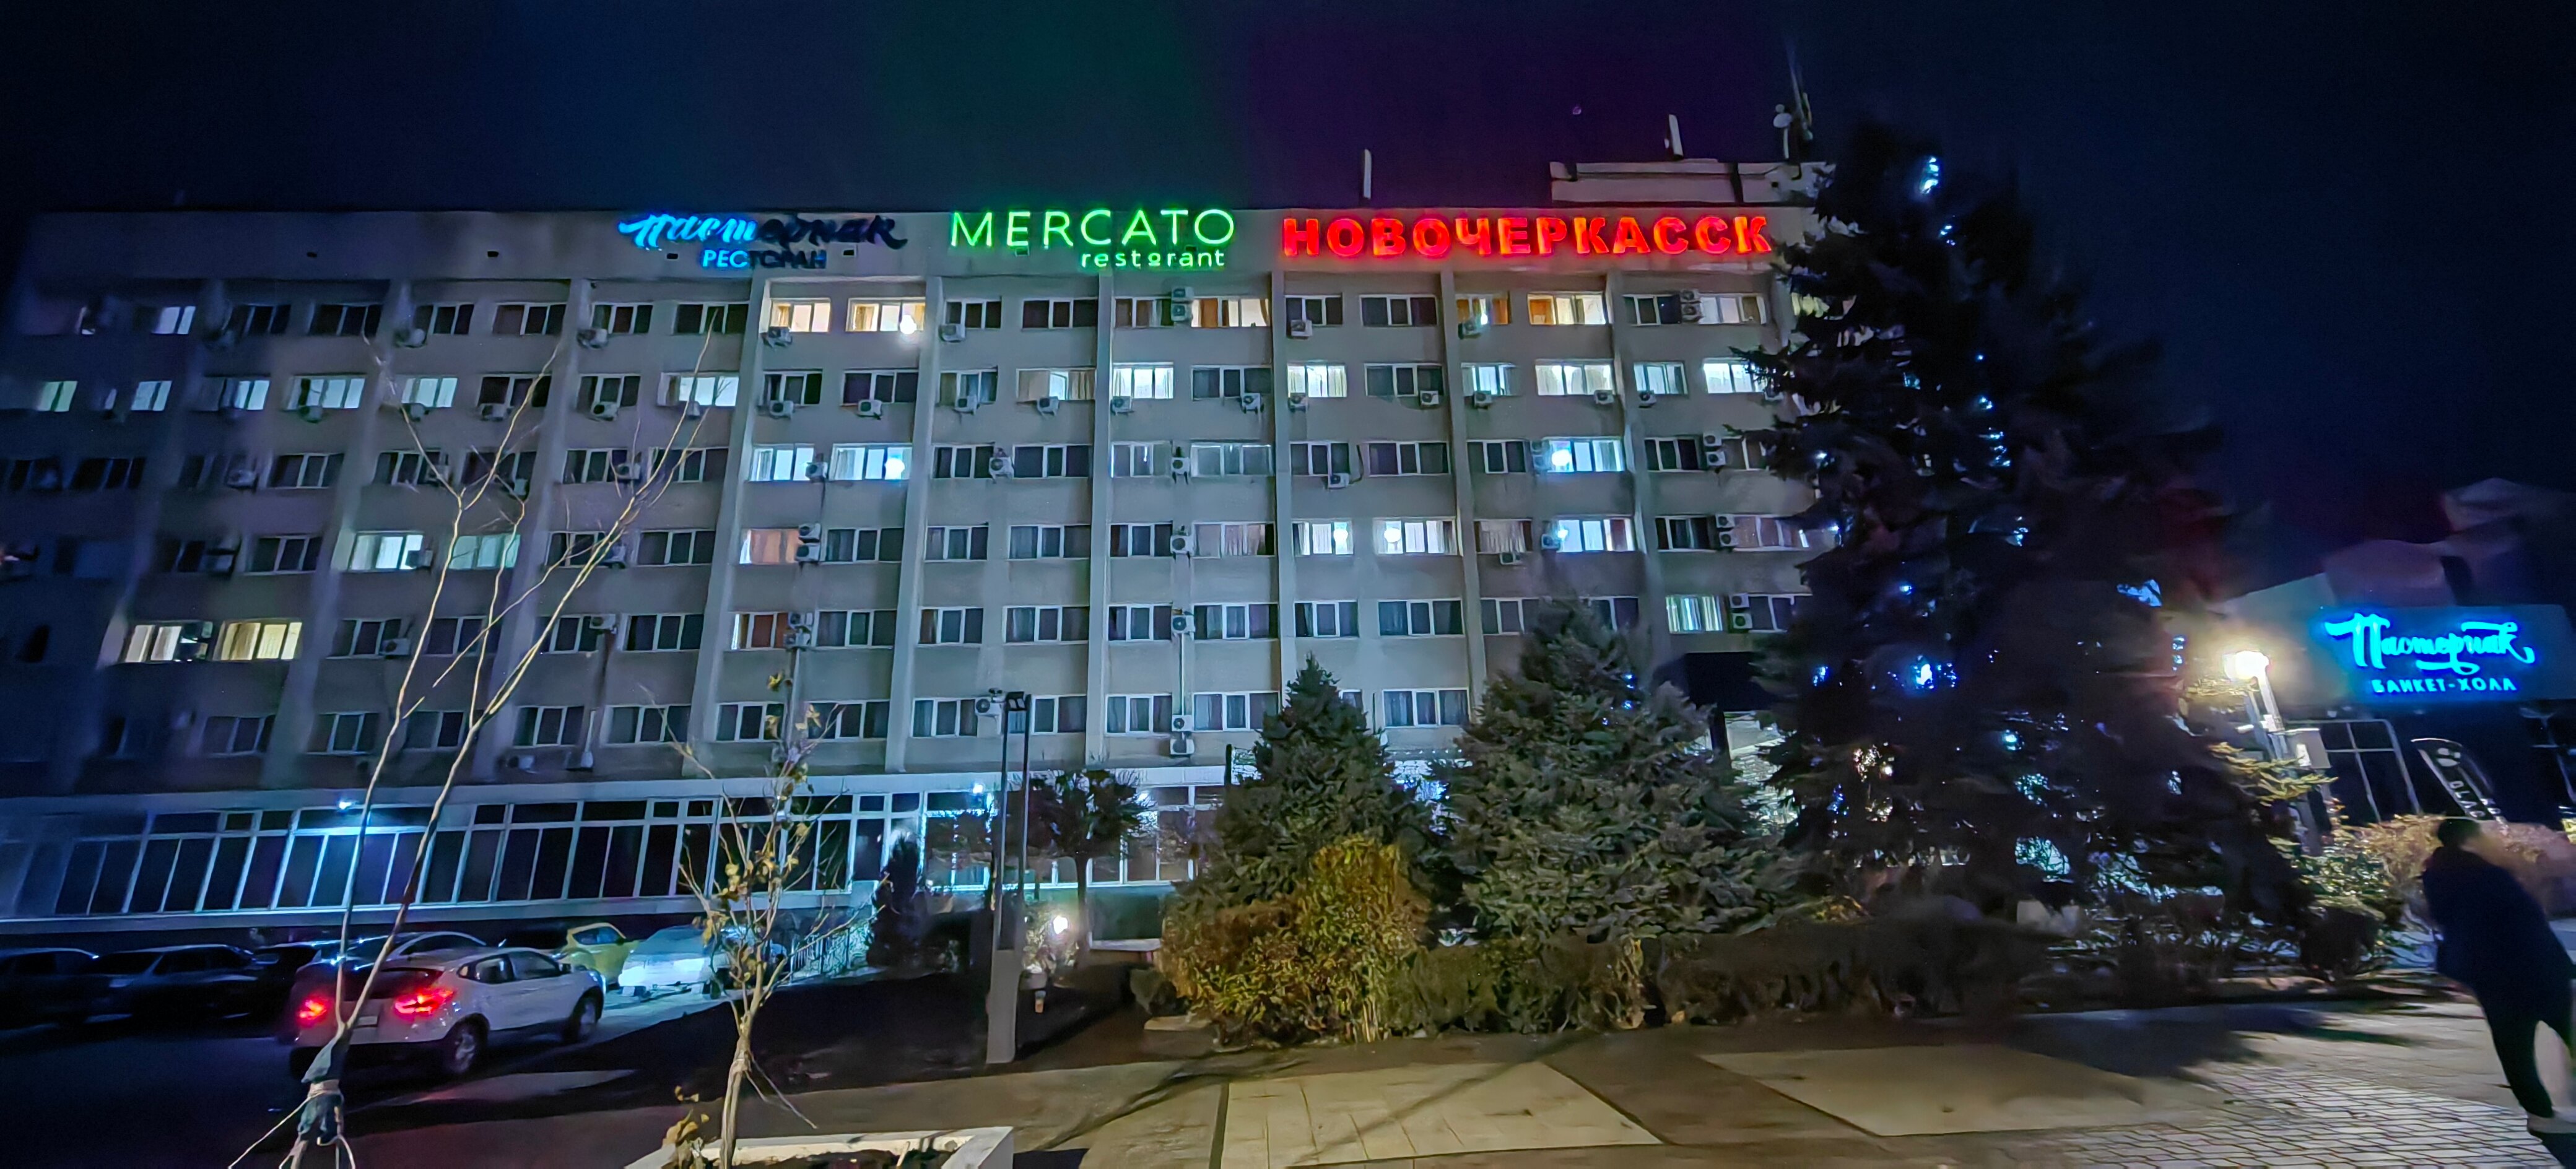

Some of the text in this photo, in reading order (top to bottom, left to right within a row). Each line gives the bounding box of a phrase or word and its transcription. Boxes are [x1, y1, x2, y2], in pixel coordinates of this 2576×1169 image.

[951, 208, 1235, 249] MERCATO
[1282, 216, 1772, 256] НОВОЧЕРКАССК
[702, 249, 827, 269] РЕСТОРАН
[1081, 250, 1225, 268] restorant
[2324, 612, 2536, 675] Пастернак
[2371, 678, 2517, 693] БАНКЕТ-ХОЛЛ
